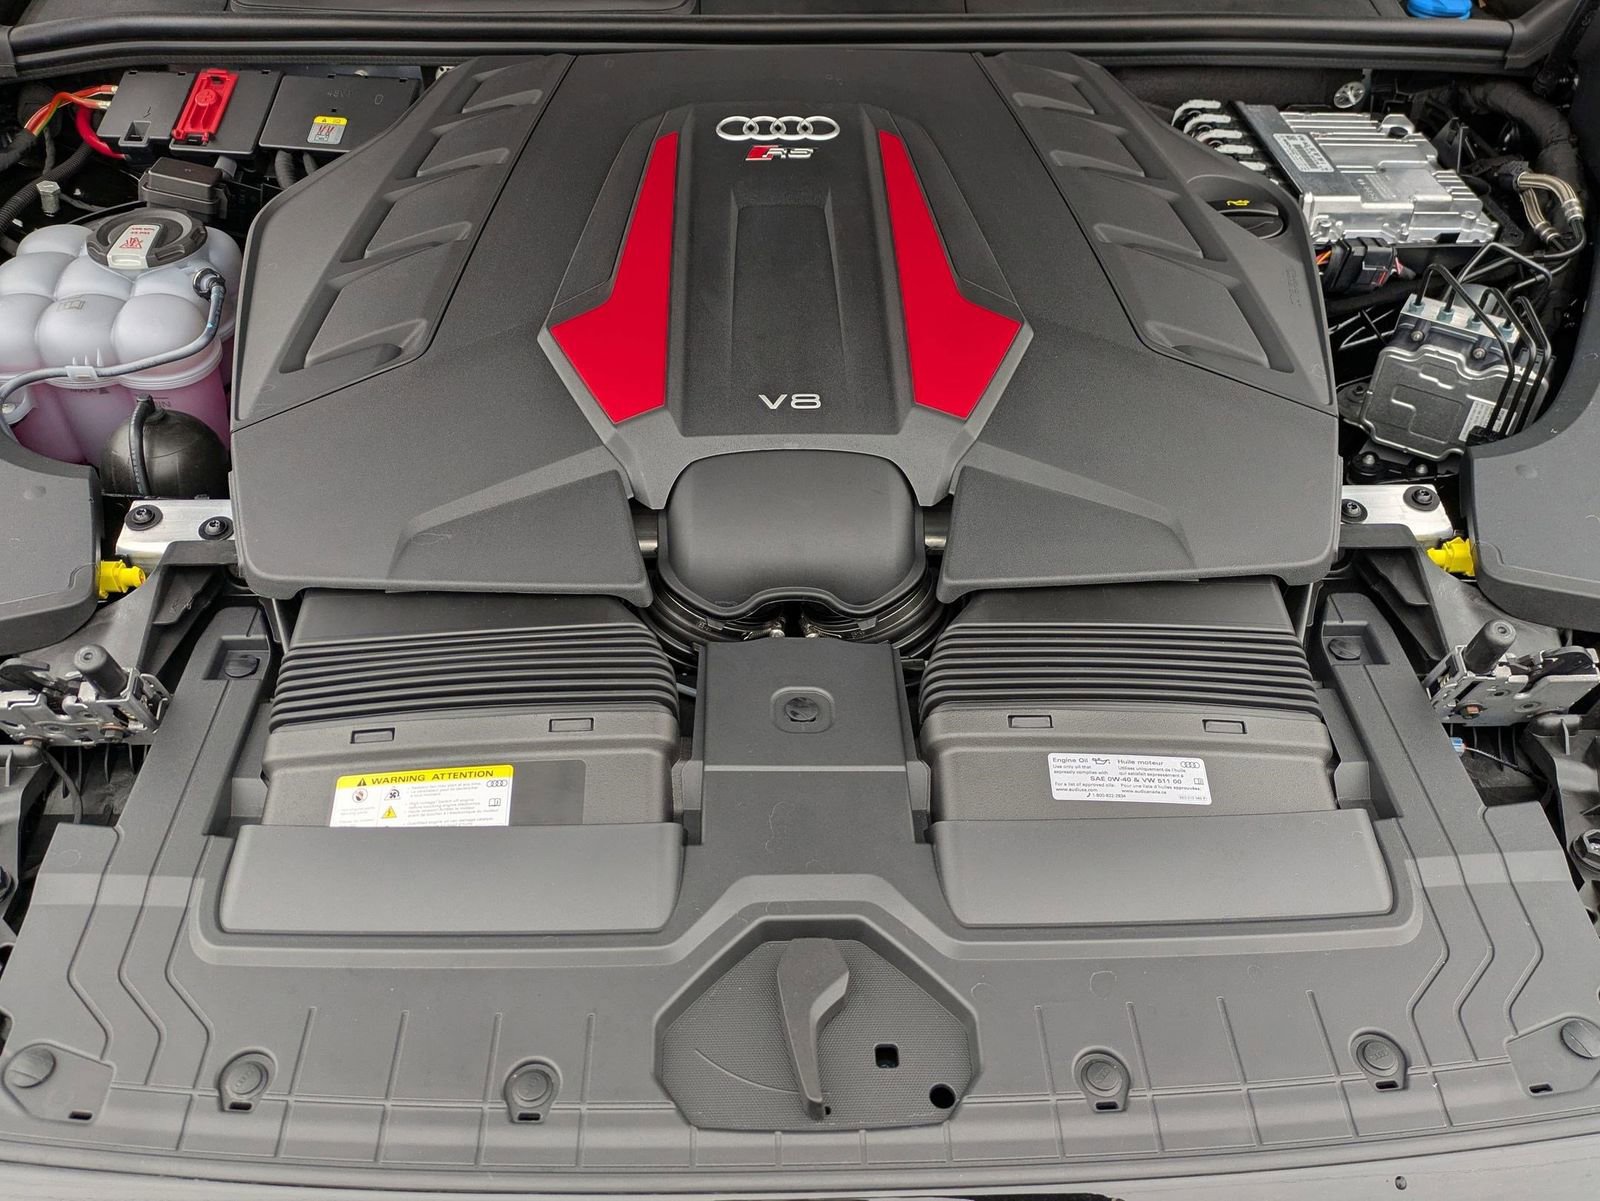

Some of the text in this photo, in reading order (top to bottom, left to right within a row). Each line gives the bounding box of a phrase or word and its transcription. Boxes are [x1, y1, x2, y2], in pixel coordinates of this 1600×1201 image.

[758, 393, 822, 409] V8
[371, 770, 494, 785] WARNING ATTENTION
